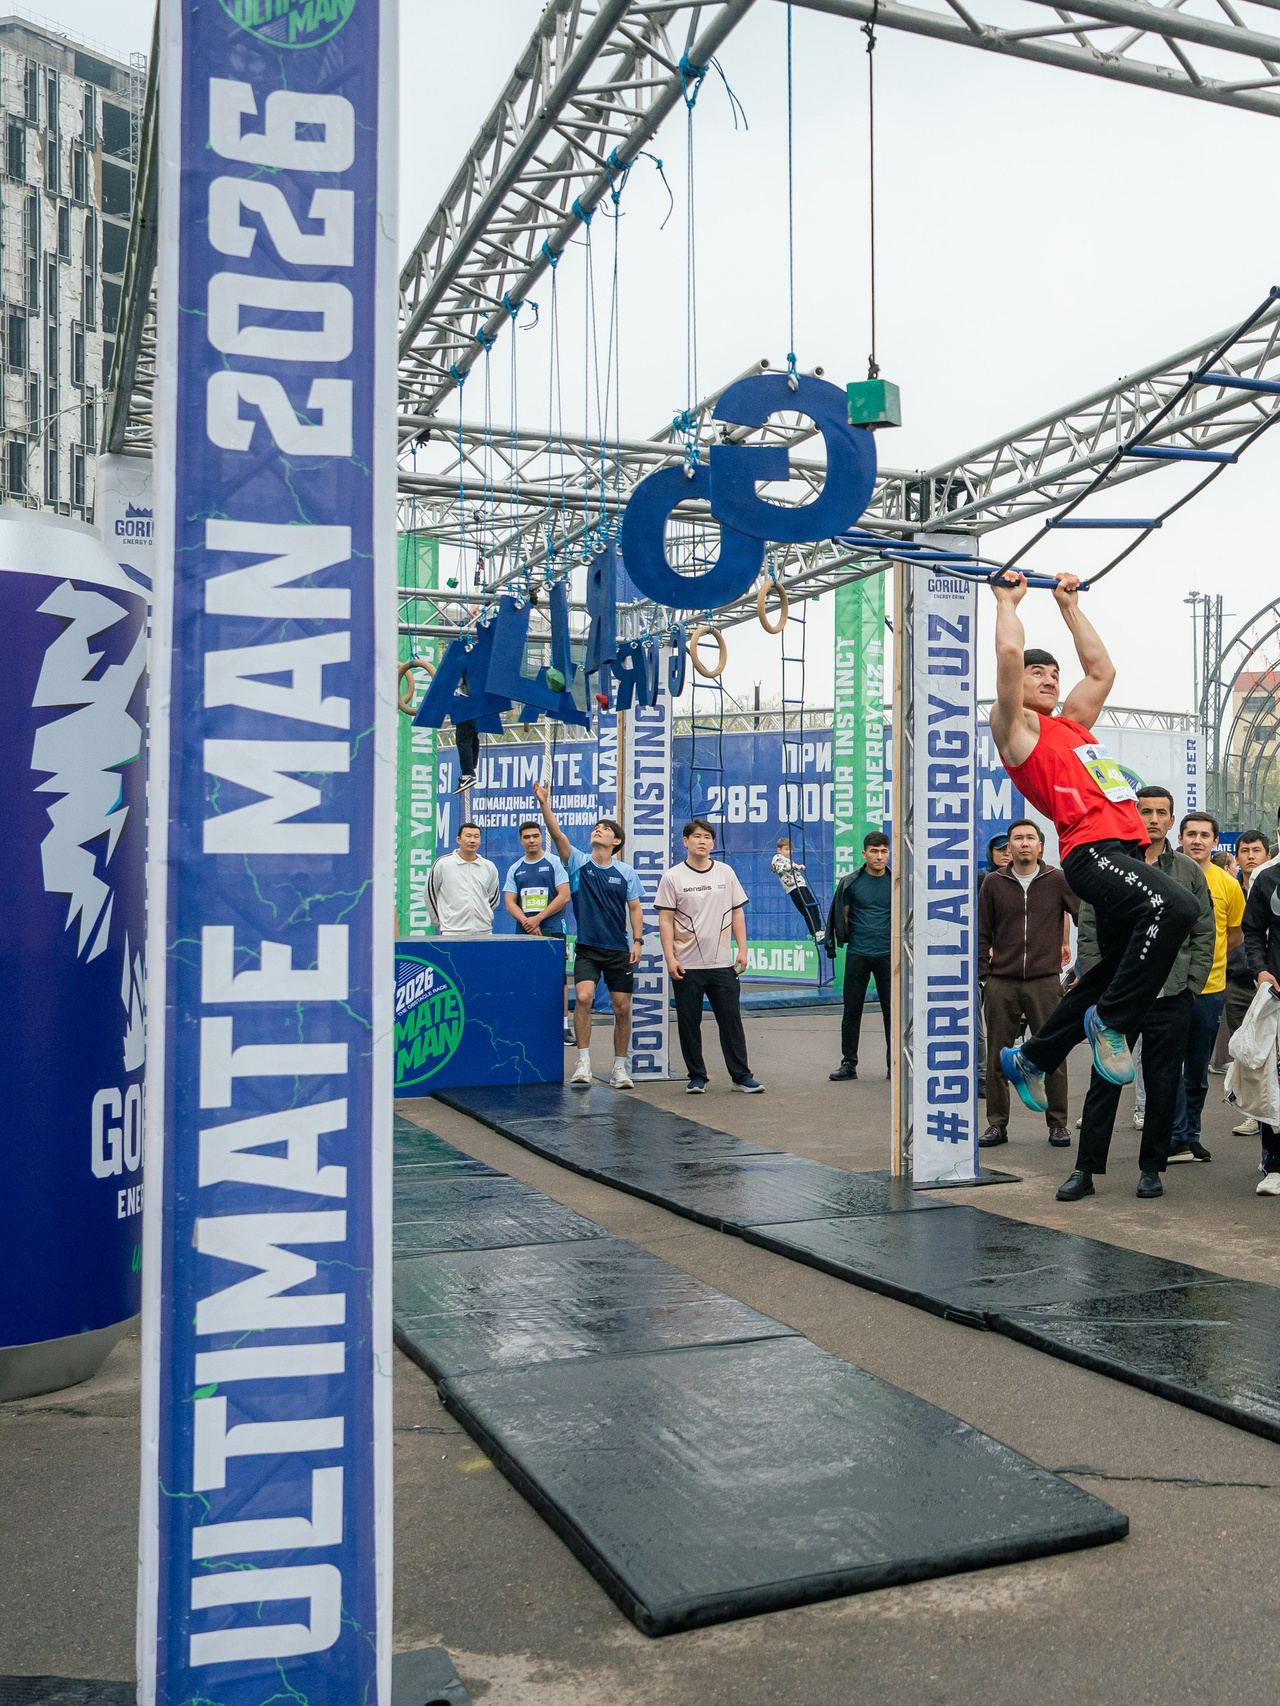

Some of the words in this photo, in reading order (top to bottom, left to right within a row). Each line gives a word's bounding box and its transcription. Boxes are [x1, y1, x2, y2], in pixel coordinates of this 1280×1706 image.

[206, 77, 356, 458] 2026
[122, 538, 148, 546] ENERGY
[928, 578, 970, 594] GORILLA
[203, 518, 352, 854] MAN
[835, 636, 855, 755] INSTINCT
[473, 753, 583, 790] ULTIMATE
[598, 727, 618, 793] MAN
[1186, 739, 1197, 775] BER
[411, 764, 433, 838] YOUR
[472, 795, 535, 812] КОМАНДНЫЕ
[550, 794, 598, 810] НДИВИД
[706, 784, 768, 824] 285
[835, 765, 854, 836] YOUR
[927, 614, 970, 1145] #GORILLAENERGY.UZ
[395, 966, 434, 1014] 2026
[397, 1007, 409, 1017] THE
[406, 992, 433, 1010] OBSTACLE
[432, 983, 448, 994] RACE
[396, 1019, 459, 1083] MAN
[91, 1082, 146, 1180] GO
[190, 924, 350, 1667] ULTIMATE
